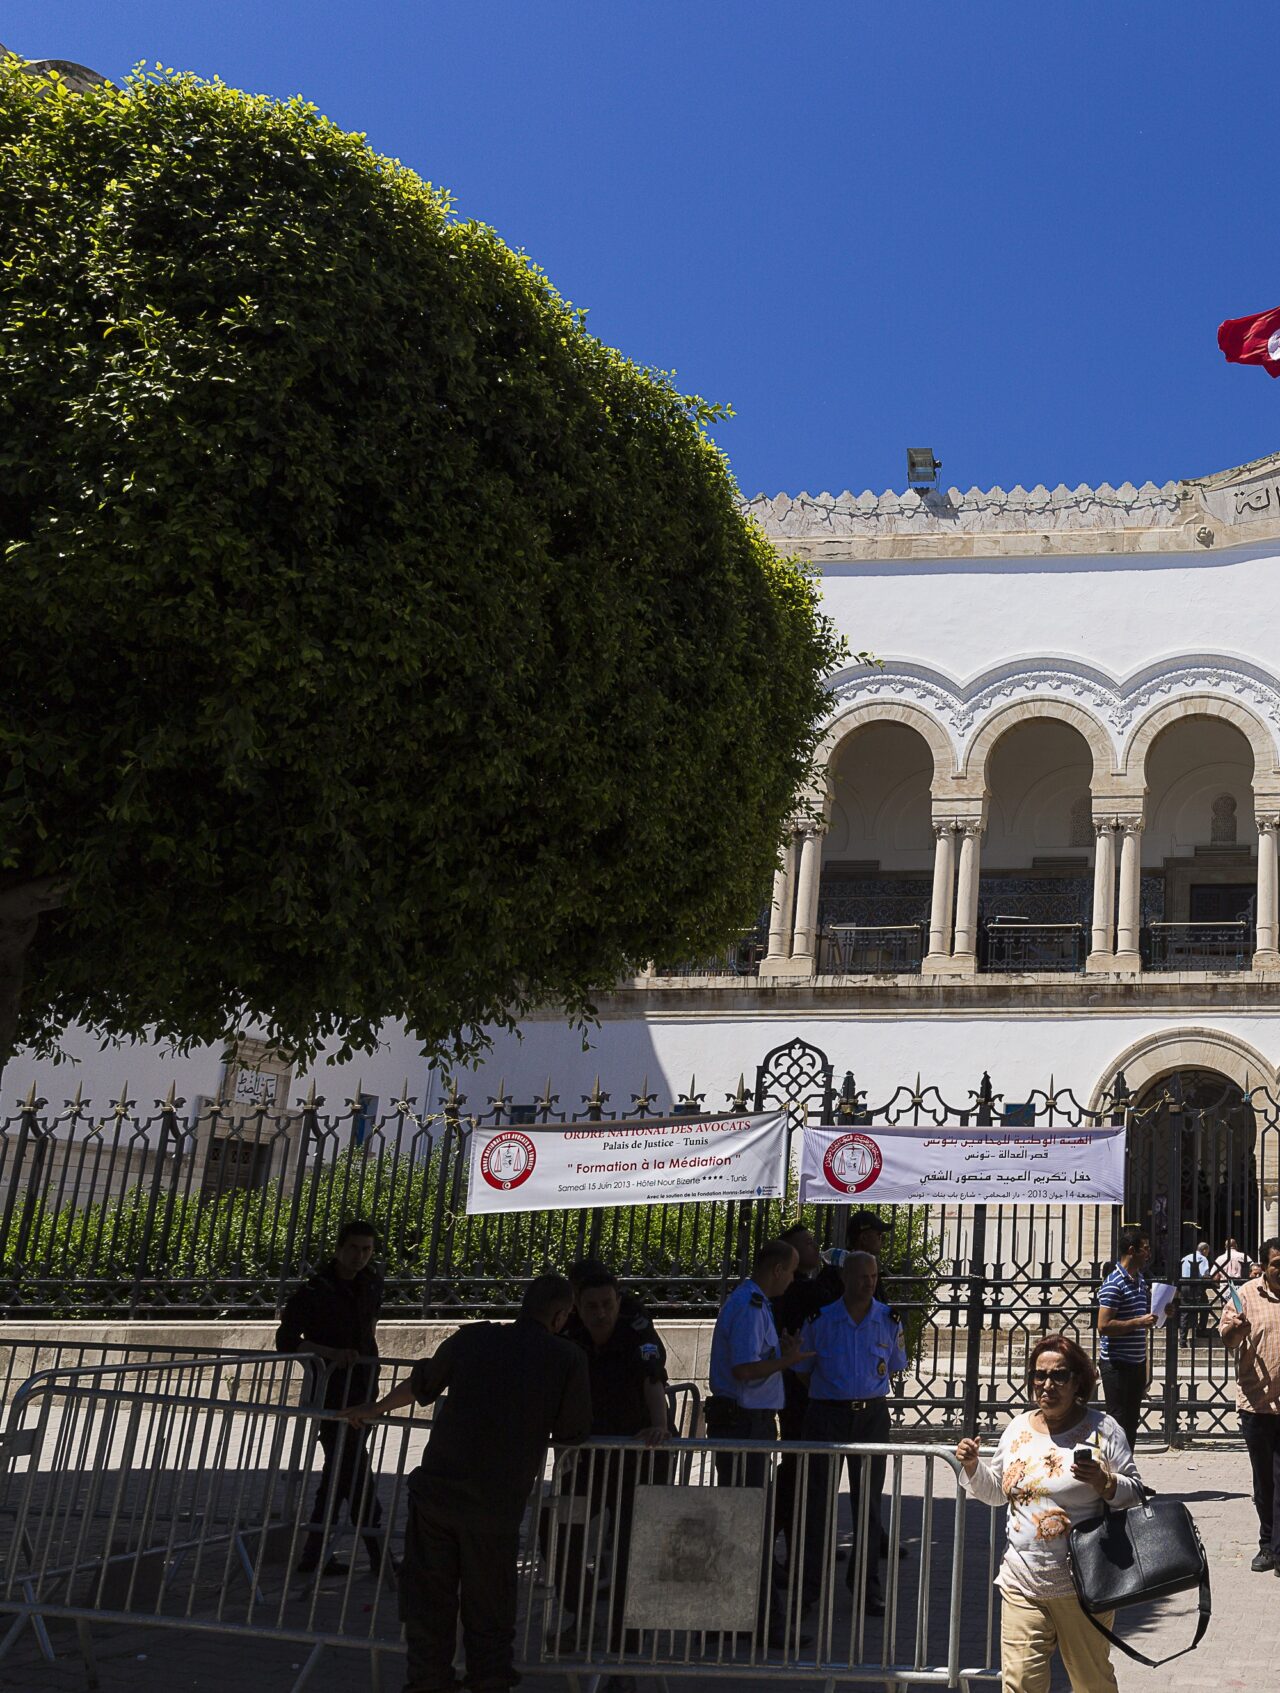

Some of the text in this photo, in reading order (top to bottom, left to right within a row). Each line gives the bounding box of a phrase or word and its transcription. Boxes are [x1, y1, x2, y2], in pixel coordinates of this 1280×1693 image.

[564, 1120, 751, 1140] ORDRE NATIONAL DES AVOCATS
[602, 1141, 629, 1150] Palais
[631, 1140, 642, 1149] de
[643, 1139, 674, 1149] Justice
[683, 1137, 708, 1146] Tunis
[923, 1135, 958, 1147] بتونس
[961, 1133, 1010, 1147] للمحامين
[1014, 1134, 1056, 1149] الوطنية
[998, 1149, 1027, 1159] العدالة
[1029, 1149, 1049, 1160] قصر
[576, 1161, 637, 1174] Formation
[641, 1159, 649, 1170] à
[653, 1159, 665, 1170] la
[669, 1156, 731, 1169] Médiation
[558, 1184, 586, 1192] Samedi
[588, 1183, 596, 1191] 15
[597, 1182, 612, 1190] Juin
[613, 1180, 631, 1189] 2013
[636, 1179, 656, 1187] Hôtel
[657, 1178, 675, 1186] Nour
[676, 1177, 700, 1185] Bizerte
[731, 1174, 747, 1182] Tunis
[920, 1170, 1091, 1185] حفل تكريم العميد منصور الشفي
[907, 1191, 925, 1199] تونس
[960, 1191, 976, 1200] شارع
[983, 1191, 1010, 1200] المحامي
[1027, 1189, 1048, 1198] 2013
[1049, 1191, 1063, 1199] جوان
[1065, 1190, 1074, 1198] 14
[1076, 1191, 1101, 1199] الجمعة
